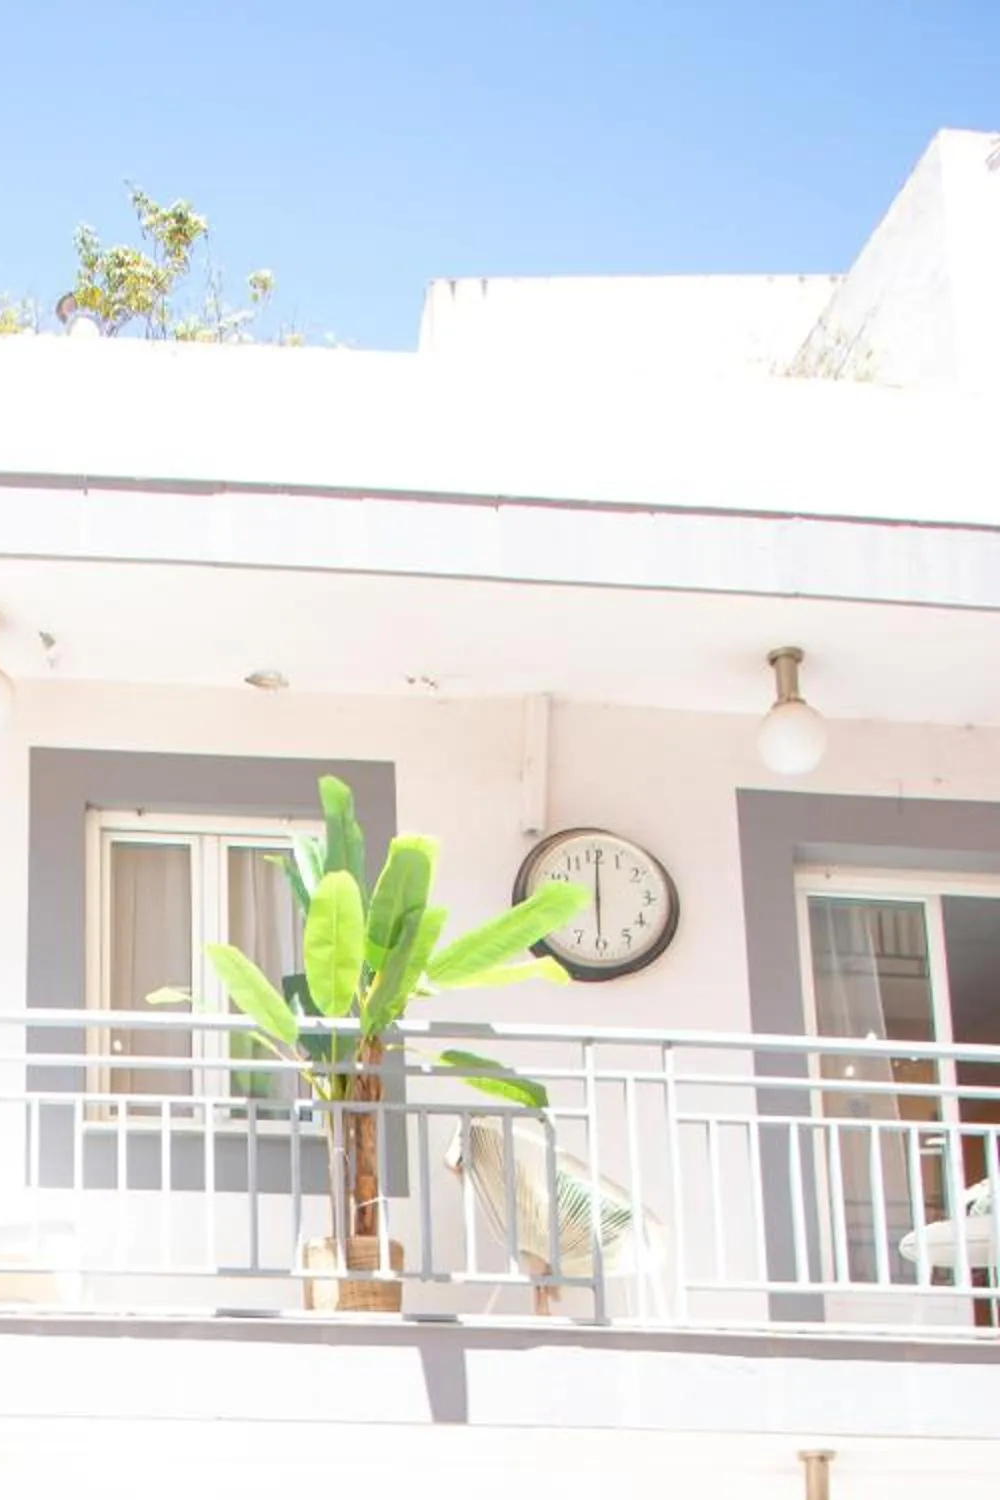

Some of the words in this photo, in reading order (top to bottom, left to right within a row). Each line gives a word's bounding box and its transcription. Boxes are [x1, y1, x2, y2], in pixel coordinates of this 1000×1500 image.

[566, 855, 581, 871] 11
[585, 849, 604, 865] 12
[614, 853, 621, 869] 1
[629, 867, 641, 883] 2
[573, 929, 585, 945] 7
[621, 928, 632, 948] 5
